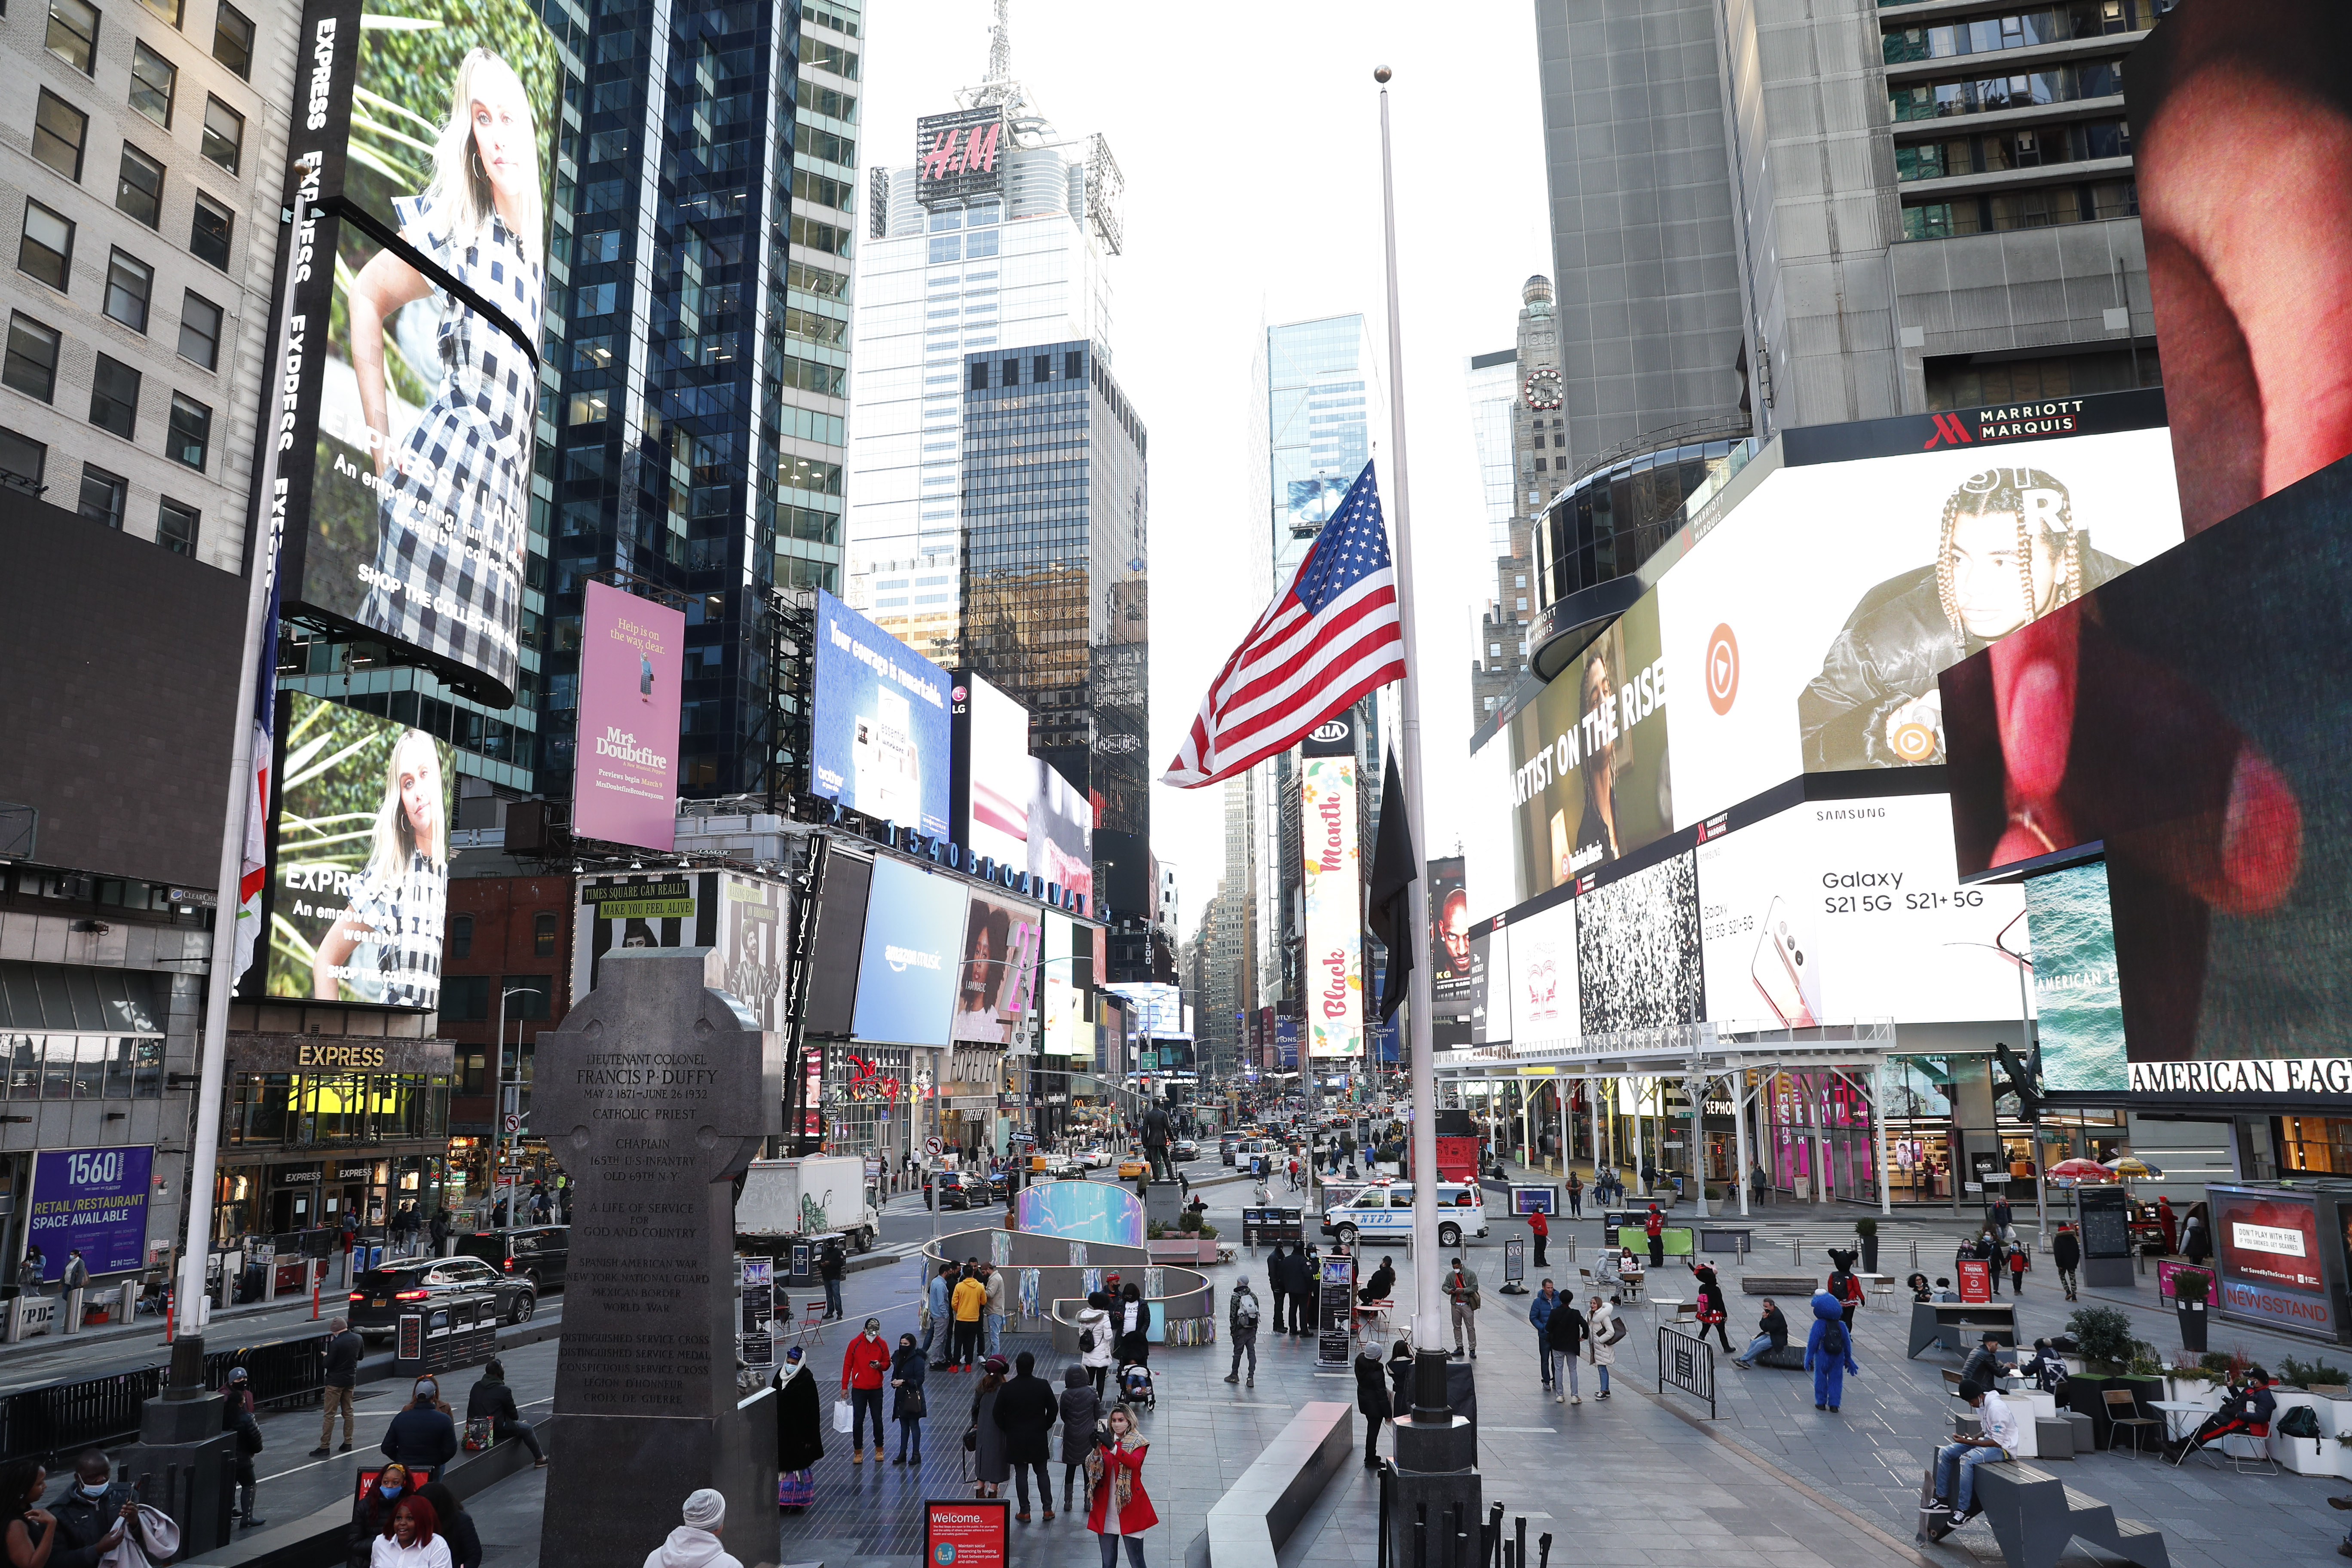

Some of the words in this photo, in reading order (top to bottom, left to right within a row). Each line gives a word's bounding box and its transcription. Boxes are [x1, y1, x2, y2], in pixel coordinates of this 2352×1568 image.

[307, 17, 337, 130] EXPRESS
[922, 122, 1000, 180] H&M
[1980, 401, 2083, 422] MARRIOTT
[1981, 418, 2074, 438] MARQUIS
[334, 453, 356, 479] An
[362, 471, 457, 533] empowering,
[462, 521, 482, 542] fun
[486, 536, 505, 557] and
[1694, 493, 1724, 529] MARRIOTT
[1695, 511, 1721, 542] MARQUIS
[394, 509, 461, 553] wearable
[465, 544, 517, 588] collection.
[358, 564, 401, 593] SHOP
[404, 583, 431, 608] THE
[434, 597, 505, 644] COLLECTION
[1529, 606, 1556, 634] MARRIOTT
[618, 618, 639, 636] Help
[640, 625, 647, 637] is
[649, 631, 659, 641] on
[1530, 623, 1553, 647] MARQUIS
[610, 628, 624, 641] the
[626, 635, 643, 650] way,
[646, 640, 665, 654] dear.
[830, 619, 851, 653] Your
[852, 640, 888, 677] courage
[889, 657, 897, 680] is
[898, 668, 943, 709] remarkable.
[952, 704, 966, 714] LG
[606, 726, 637, 745] Mrs.
[882, 723, 906, 744] essential
[1314, 726, 1341, 738] KIA
[1510, 744, 1553, 810] ARTIST
[1557, 723, 1580, 776] ON
[1581, 693, 1618, 756] THE
[1622, 655, 1666, 731] RISE
[596, 737, 666, 769] Doubtfire
[598, 769, 623, 780] Previews
[625, 775, 640, 784] begin
[641, 778, 658, 787] March
[818, 766, 843, 787] brother
[596, 780, 664, 800] MrsDoubtfireBroadway.com
[1706, 812, 1728, 828] MARRIOTT
[1817, 808, 1885, 821] SAMSUNG
[1319, 792, 1341, 871] Month
[1707, 824, 1726, 838] MARQUIS
[881, 820, 959, 868] 1540
[963, 848, 1087, 914] BROADWAY
[1822, 872, 1903, 890] Galaxy
[585, 888, 606, 900] TIMES
[609, 885, 638, 899] SQUARE
[641, 885, 655, 896] CAN
[658, 882, 687, 895] REALLY
[729, 885, 744, 898] RAISING
[745, 889, 760, 901] SPIRITS
[603, 904, 625, 916] MAKE
[628, 903, 642, 914] YOU
[646, 903, 664, 914] FEEL
[668, 901, 692, 913] ALIVE!
[1825, 897, 1855, 913] S21
[1863, 895, 1892, 911] 5G
[1906, 893, 1948, 910] S21+
[1954, 891, 1983, 907] 5G
[747, 906, 752, 915] ON
[753, 907, 775, 920] BROADWAY!
[1704, 903, 1727, 920] Galaxy
[343, 929, 400, 946] wearable
[327, 965, 358, 980] SHOP
[1436, 971, 1451, 979] KG
[1472, 964, 1484, 974] MICKEY
[1323, 948, 1347, 1020] Black
[1472, 974, 1484, 985] MOUSE
[2038, 971, 2101, 992] AMERICAN
[299, 1046, 384, 1066] EXPRESS
[587, 1054, 651, 1065] LIEUTENANT
[654, 1054, 707, 1065] COLONEL
[950, 1050, 998, 1082] FOREVER
[577, 1070, 640, 1084] FRANCIS
[662, 1070, 718, 1084] DUFFY
[584, 1090, 605, 1098] MAY
[608, 1090, 613, 1098] 2
[671, 1090, 682, 1098] 26
[685, 1090, 707, 1099] 1932
[593, 1109, 649, 1119] CATHOLIC
[655, 1109, 696, 1119] PRIEST
[962, 1109, 983, 1121] FOREVER
[983, 1109, 989, 1121] 21
[68, 1152, 116, 1185] 1560
[286, 1172, 322, 1182] EXPRESS
[340, 1168, 372, 1178] EXPRESS
[34, 1194, 145, 1215] RETAIL/RESTAURANT
[589, 1204, 597, 1212] A
[602, 1204, 624, 1212] LIFE
[629, 1204, 645, 1213] OF
[648, 1204, 694, 1213] SERVICE
[33, 1215, 69, 1230] SPACE
[71, 1209, 128, 1225] AVAILABLE
[631, 1216, 649, 1225] FOR
[1360, 1215, 1393, 1223] NYPD
[584, 1227, 610, 1236] GOD
[613, 1228, 637, 1237] AND
[643, 1228, 696, 1237] COUNTRY
[2239, 1228, 2253, 1237] DON'T
[2254, 1230, 2268, 1239] PLAY
[2269, 1232, 2282, 1240] WITH
[2285, 1234, 2298, 1243] FIRE.
[580, 1258, 617, 1267] SPANISH
[621, 1259, 672, 1268] AMERICAN
[676, 1260, 697, 1268] WAR
[566, 1273, 588, 1281] NEW
[591, 1273, 617, 1282] YORK
[622, 1274, 671, 1283] NATIONAL
[674, 1275, 709, 1283] GUARD
[2249, 1268, 2294, 1281] SavedByTheScan.org
[603, 1303, 640, 1311] WORLD
[647, 1303, 669, 1312] WAR
[2226, 1289, 2327, 1322] NEWSSTAND
[932, 1513, 983, 1522] Welcome.
